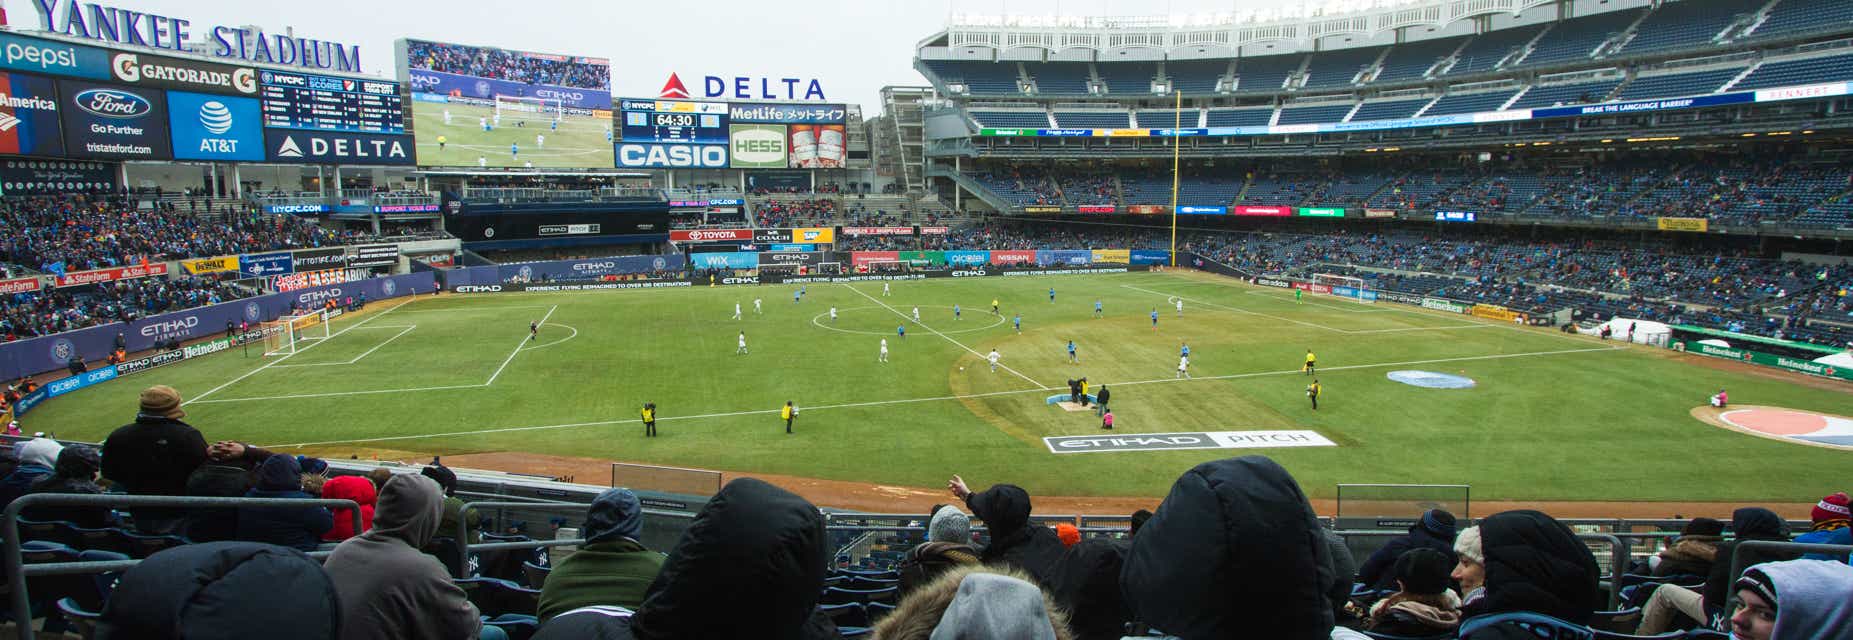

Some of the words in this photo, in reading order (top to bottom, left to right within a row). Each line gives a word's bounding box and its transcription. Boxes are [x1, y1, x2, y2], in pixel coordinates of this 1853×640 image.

[33, 0, 192, 52] YANKEE
[212, 25, 362, 73] STADIUM
[6, 43, 77, 68] pepsi
[142, 64, 231, 86] GATORADE
[274, 75, 305, 85] NYCFC
[705, 76, 825, 99] DELTA
[0, 93, 56, 110] America
[91, 92, 136, 114] Ford
[1582, 106, 1603, 114] BREAK
[1619, 102, 1658, 111] LANGUAGE
[657, 115, 692, 126] 64:30
[731, 107, 784, 121] MetLife
[91, 124, 106, 133] Go
[108, 125, 143, 135] Further
[87, 143, 151, 154] tristateford.com
[200, 139, 238, 153] AT&T
[311, 137, 406, 158] DELTA
[735, 140, 782, 153] HESS
[620, 144, 727, 167] CASIO
[702, 231, 736, 239] TOYOTA
[803, 231, 820, 240] SAP
[573, 261, 615, 270] ETIHAD
[299, 288, 342, 303] ETIHAD
[456, 285, 502, 293] ETIHAD
[1422, 300, 1463, 313] Heineken
[141, 316, 199, 337] ETIHAD
[184, 338, 230, 359] Heineken
[1702, 344, 1742, 359] Heineken
[152, 350, 182, 363] ETIHAD
[117, 358, 150, 372] ETIHAD
[1778, 357, 1822, 374] Heineken
[1059, 435, 1201, 448] ETIHAD
[1229, 433, 1310, 444] PITCH
